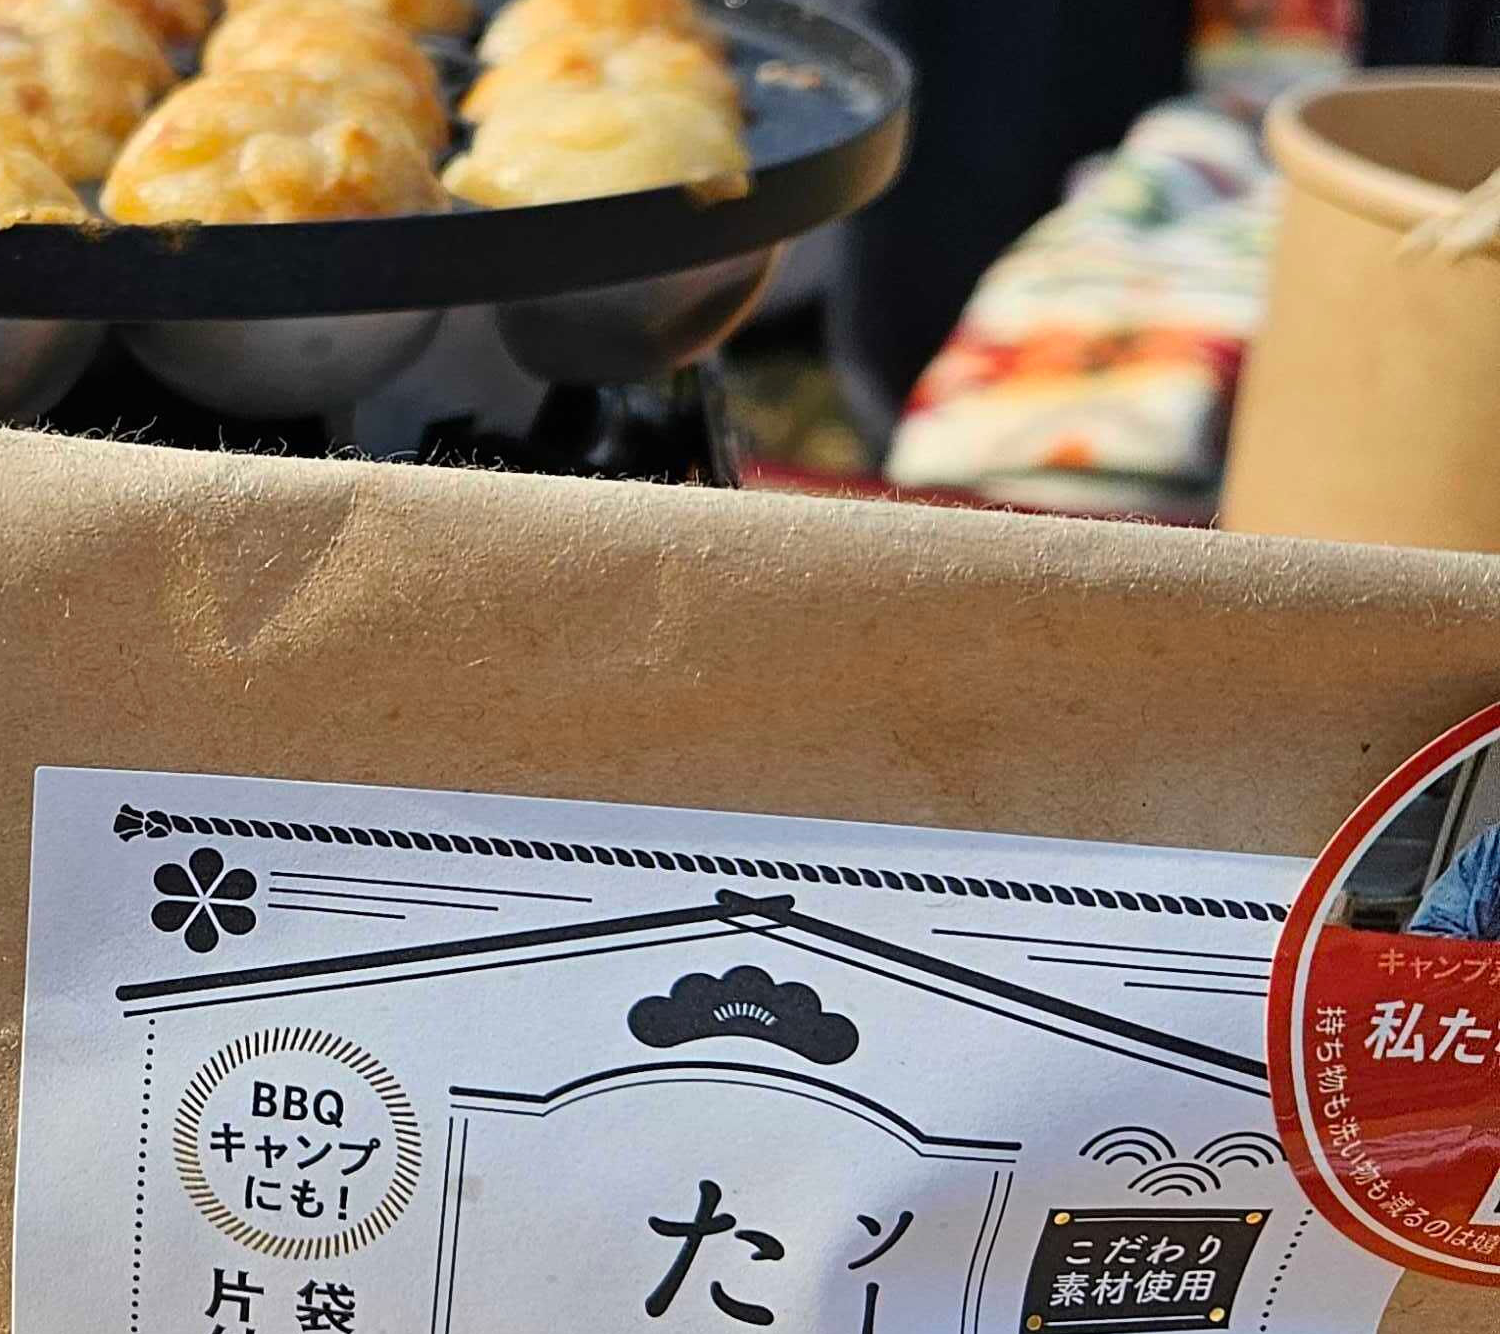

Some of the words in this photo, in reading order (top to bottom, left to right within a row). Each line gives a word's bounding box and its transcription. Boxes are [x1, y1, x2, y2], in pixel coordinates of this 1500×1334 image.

[1364, 1000, 1500, 1067] 私た
[251, 1080, 344, 1128] BBQ
[209, 1123, 381, 1176] キャンプ
[1062, 1234, 1224, 1267] こだわり
[1051, 1269, 1216, 1307] 素材使用
